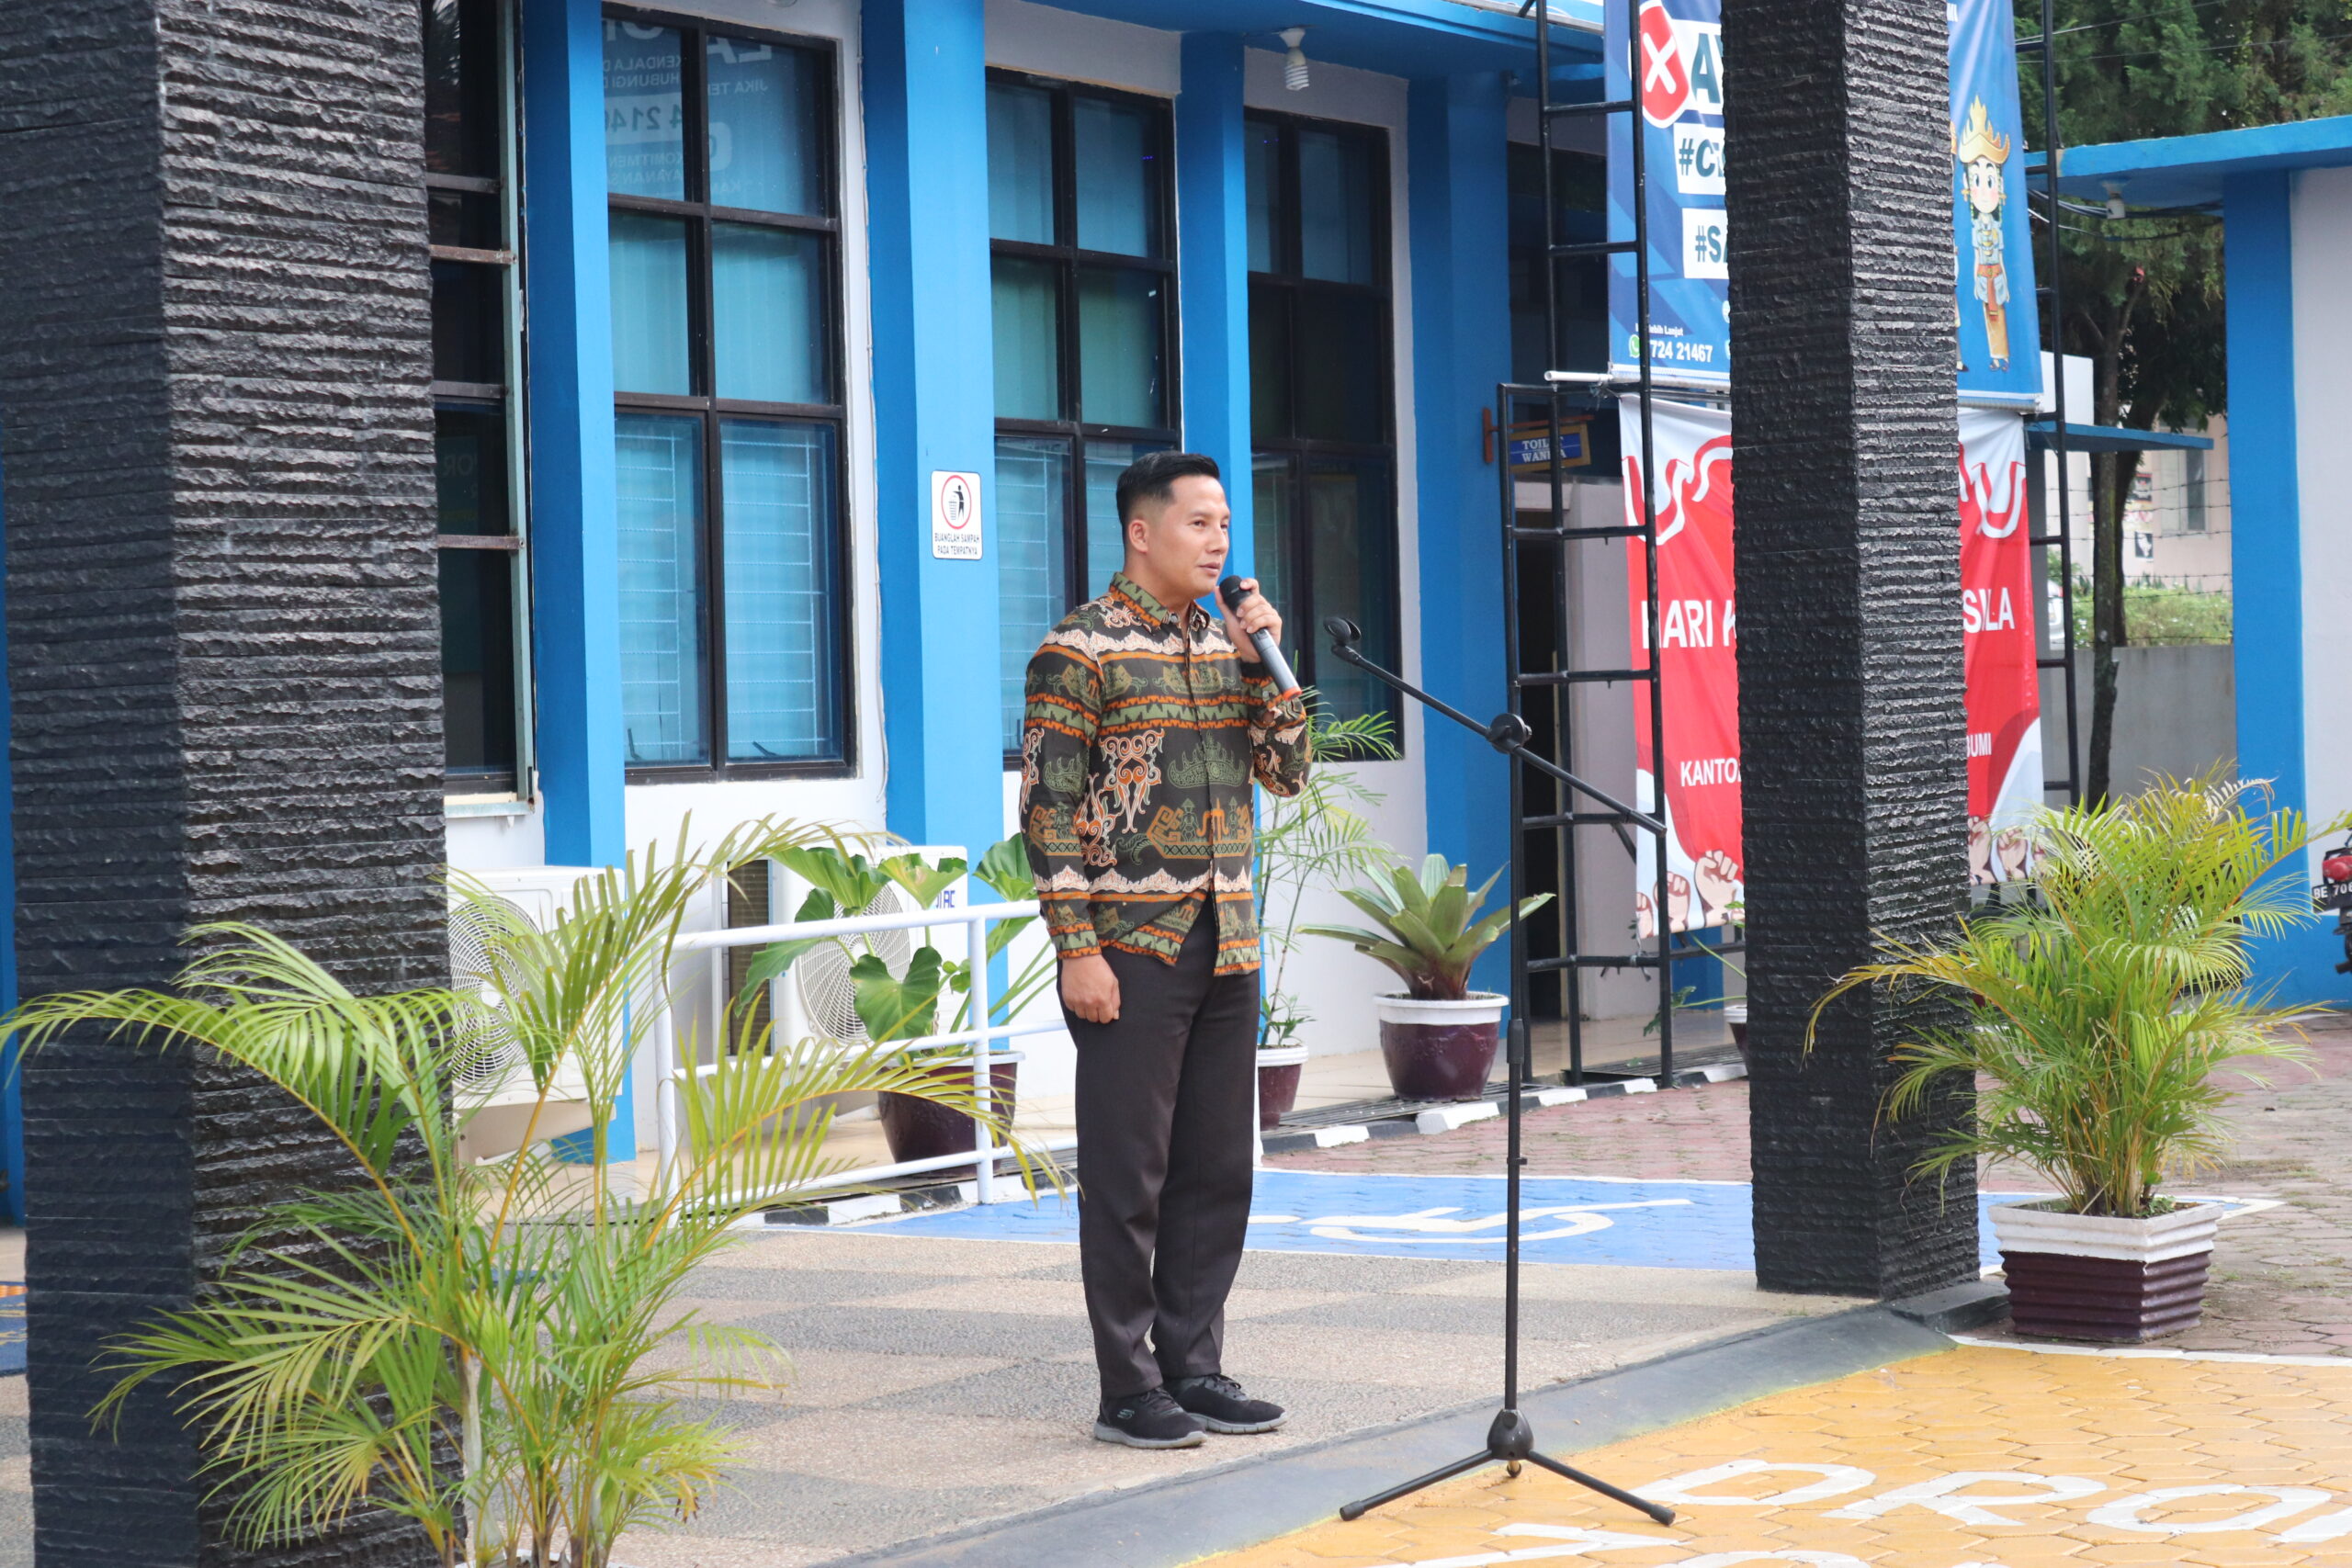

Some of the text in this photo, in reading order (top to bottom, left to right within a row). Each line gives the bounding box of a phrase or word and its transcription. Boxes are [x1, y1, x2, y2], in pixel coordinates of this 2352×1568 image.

[1690, 31, 1724, 105] A
[1695, 225, 1728, 264] #S
[1676, 341, 1713, 363] 21467
[1521, 436, 1565, 450] TOIL
[934, 533, 979, 543] BUANGLAH SAMPAH
[937, 545, 978, 555] PADA TEMPATNYA
[1680, 757, 1742, 787] KANTO
[2312, 886, 2329, 899] BE
